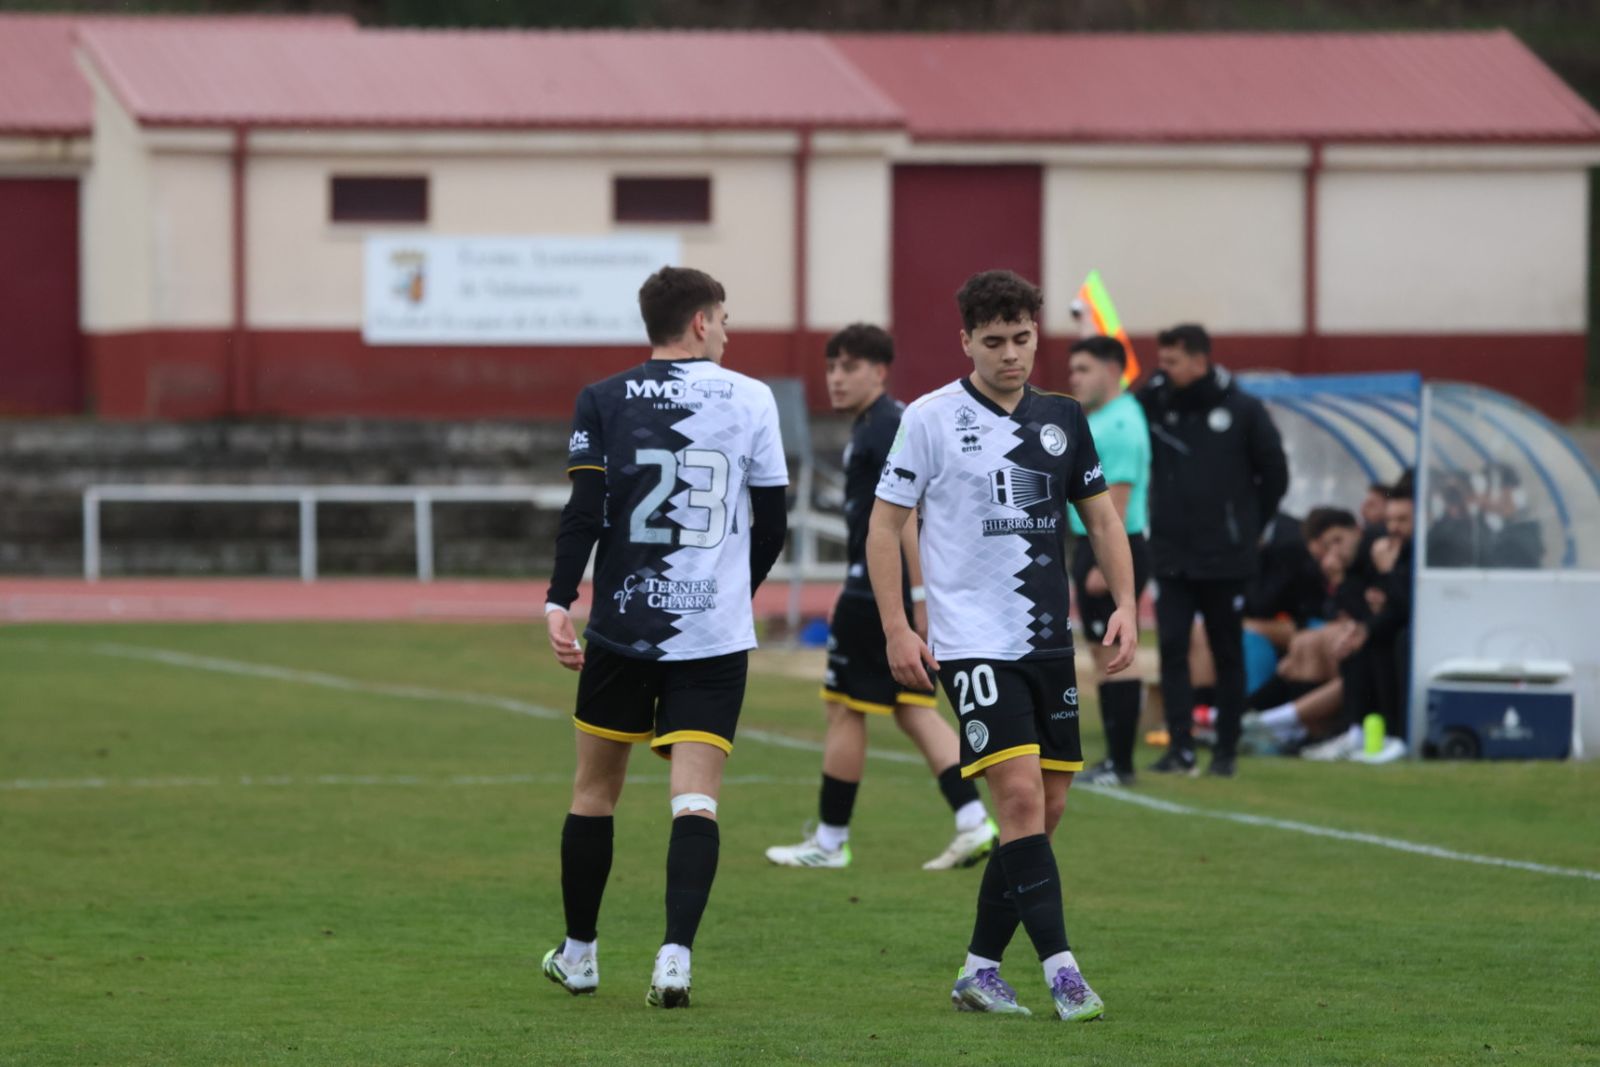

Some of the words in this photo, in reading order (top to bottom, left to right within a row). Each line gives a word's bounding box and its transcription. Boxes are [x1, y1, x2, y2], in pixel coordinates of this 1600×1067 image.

[625, 379, 686, 400] MMG
[630, 448, 730, 549] 23
[983, 518, 1034, 531] HIERROS
[645, 577, 718, 594] TERNERA
[647, 593, 716, 609] CHARRA
[953, 663, 999, 716] 20
